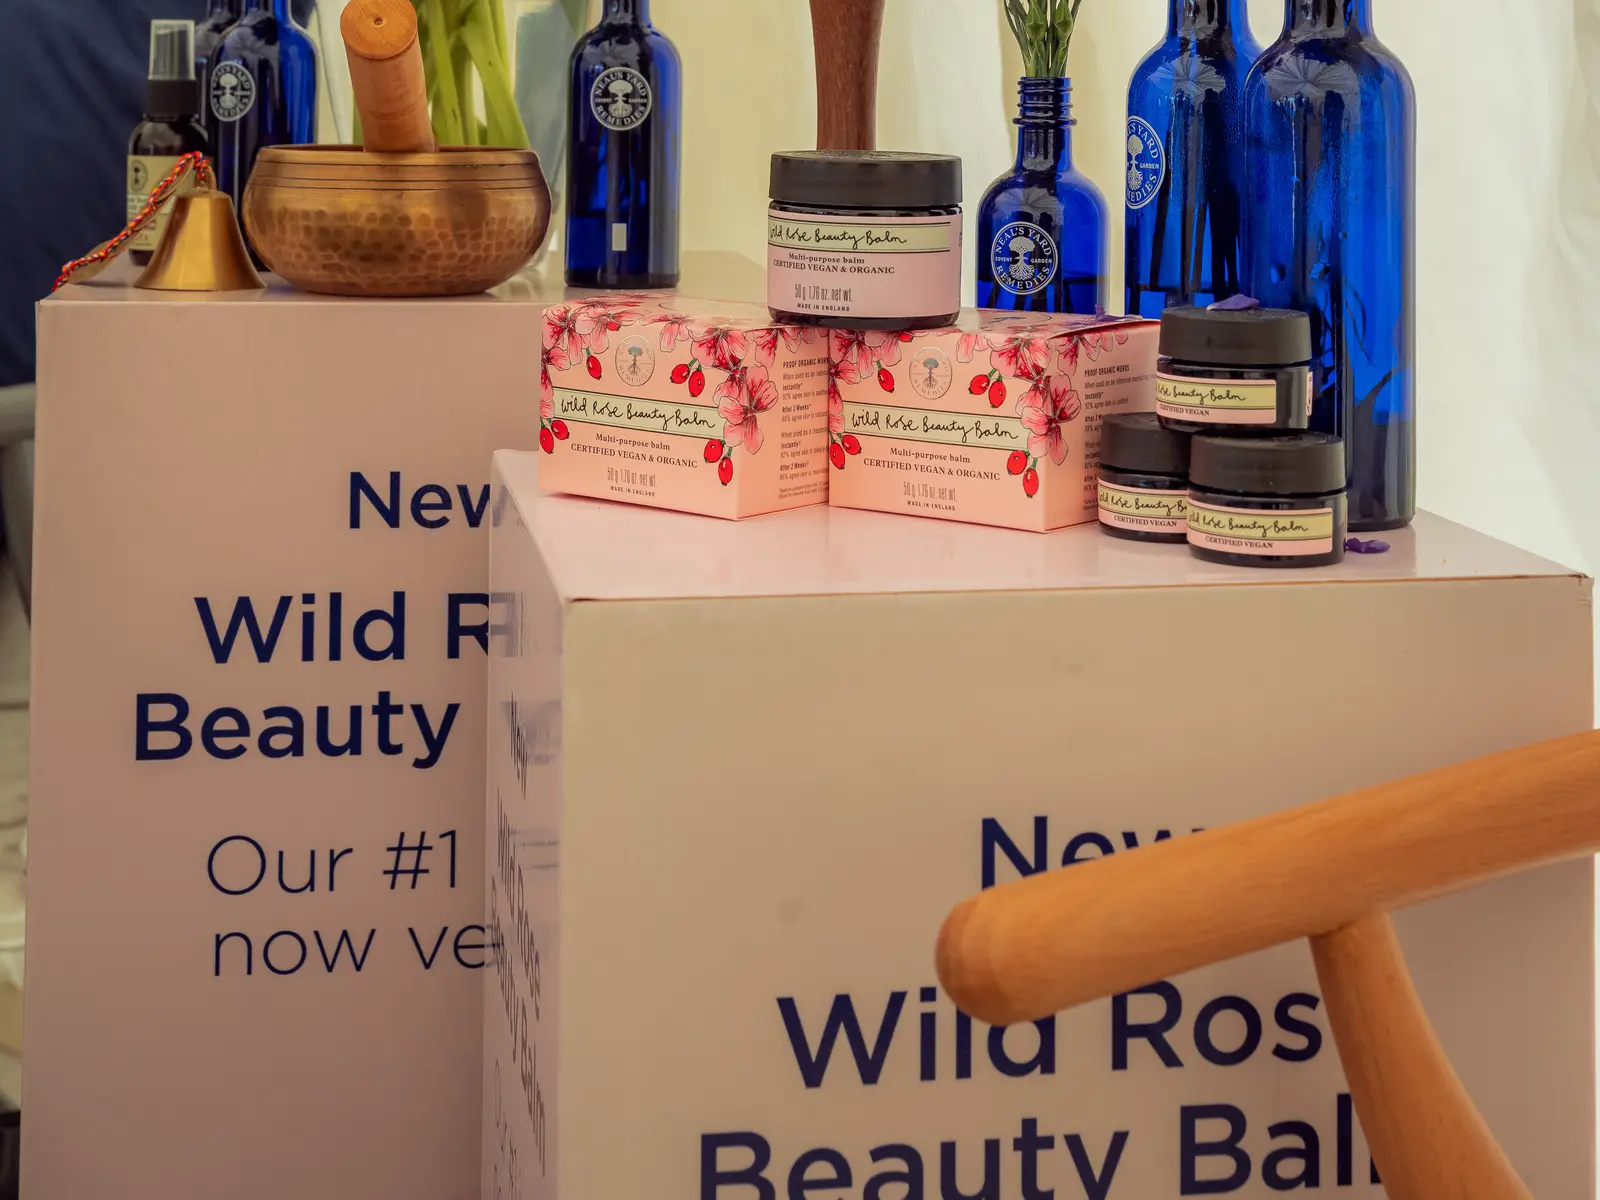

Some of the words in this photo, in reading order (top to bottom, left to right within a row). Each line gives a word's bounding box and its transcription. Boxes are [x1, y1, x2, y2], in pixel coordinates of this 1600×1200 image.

[626, 72, 647, 97] YARD
[1137, 124, 1159, 159] YARD
[815, 228, 865, 250] Beauty
[865, 230, 907, 245] Balm
[995, 226, 1025, 253] NEAL'S
[1028, 228, 1052, 255] YARD
[773, 259, 806, 270] CERTIFIED
[808, 264, 838, 272] VEGAN
[850, 266, 895, 274] ORGANIC
[788, 252, 840, 264] Multi-purpose
[843, 256, 865, 264] balm
[996, 265, 1050, 289] REMEDIES
[1209, 389, 1246, 402] Balm
[561, 396, 588, 417] Wild
[592, 401, 623, 418] Rose
[626, 403, 674, 431] Beauty
[674, 409, 715, 428] Balm
[1185, 407, 1210, 416] VEGAN
[852, 409, 881, 430] Wild
[885, 414, 919, 431] Rose
[922, 416, 974, 443] Beauty
[974, 420, 1019, 439] Balm
[596, 433, 649, 449] Multi-purpose
[651, 441, 670, 451] balm
[571, 443, 616, 457] CERTIFIED
[617, 449, 647, 462] VEGAN
[648, 454, 655, 462] &
[656, 456, 698, 468] ORGANIC
[889, 447, 947, 461] Multi-purpose
[950, 455, 971, 463] balm
[863, 458, 912, 471] CERTIFIED
[914, 464, 945, 475] VEGAN
[947, 468, 954, 476] &
[956, 469, 1000, 481] ORGANIC
[1134, 498, 1177, 516] Beauty
[1114, 515, 1149, 525] CERTIFIED
[1150, 519, 1177, 527] VEGAN
[1228, 519, 1272, 538] Beauty
[1273, 521, 1308, 534] Balm
[1205, 535, 1243, 548] CERTIFIED
[1244, 540, 1274, 549] VEGAN
[194, 591, 406, 664] Wild
[135, 691, 461, 769] Beauty
[207, 835, 353, 895] Our
[383, 830, 457, 890] #1
[214, 929, 376, 976] now
[776, 986, 1056, 1089] Wild
[1111, 979, 1322, 1071] Ros
[700, 1117, 1130, 1200] Beauty
[1180, 1092, 1382, 1196] Bal
